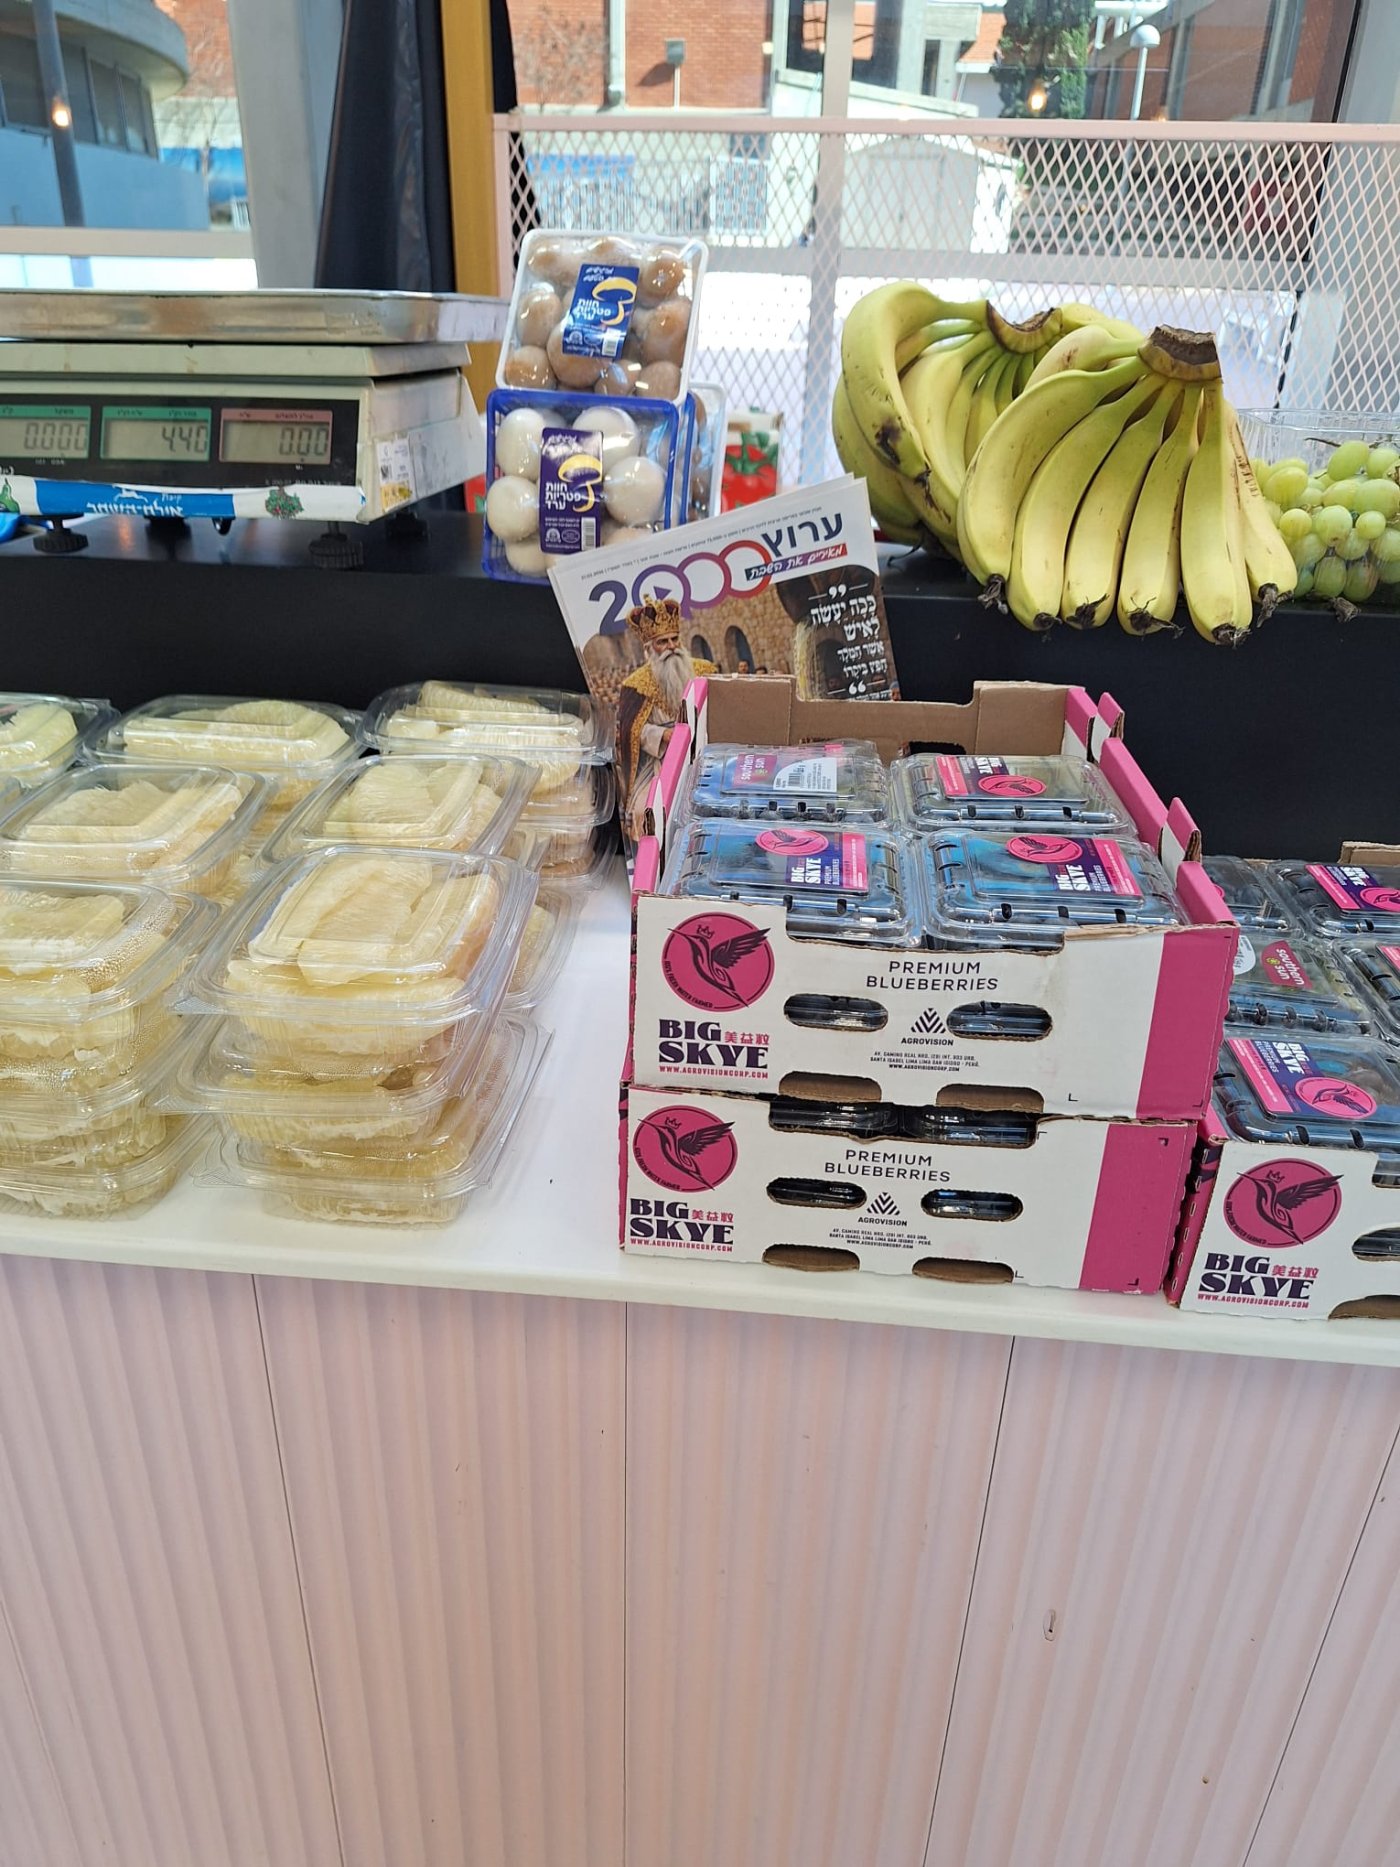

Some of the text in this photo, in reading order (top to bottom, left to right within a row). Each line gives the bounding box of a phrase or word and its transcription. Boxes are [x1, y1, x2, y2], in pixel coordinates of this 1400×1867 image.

[545, 482, 568, 492] חוות
[545, 491, 581, 502] פטריות
[545, 500, 566, 510] ערד
[761, 513, 843, 558] ערוץ
[750, 562, 783, 579] השבת
[786, 556, 803, 570] את
[791, 866, 805, 883] BIG
[804, 857, 821, 884] SKYE
[1065, 864, 1091, 891] SKYE
[1055, 874, 1074, 890] BIG
[888, 960, 981, 975] PREMIUM
[1274, 964, 1290, 980] sun
[1276, 948, 1305, 985] southern
[866, 975, 999, 991] BLUEBERRIES
[659, 1018, 722, 1042] BIG
[901, 1037, 954, 1047] AGROVISION
[658, 1040, 769, 1069] SKYE
[1272, 1041, 1305, 1074] SKYE
[1287, 1042, 1309, 1062] BIG
[659, 1065, 769, 1079] WWW.AGROVISIONCORP.COM
[845, 1149, 932, 1167] PREMIUM
[824, 1162, 951, 1182] BLUEBERRIES
[630, 1198, 690, 1220] BIG
[858, 1216, 908, 1227] AGROVISION
[630, 1217, 734, 1245] SKYE
[630, 1237, 733, 1252] WWW.AGROVISIONCORP.COM
[1204, 1252, 1270, 1275] BIG
[1198, 1272, 1315, 1300] SKYE
[1197, 1293, 1309, 1309] WWW.AGROVISIONCORP.COM
